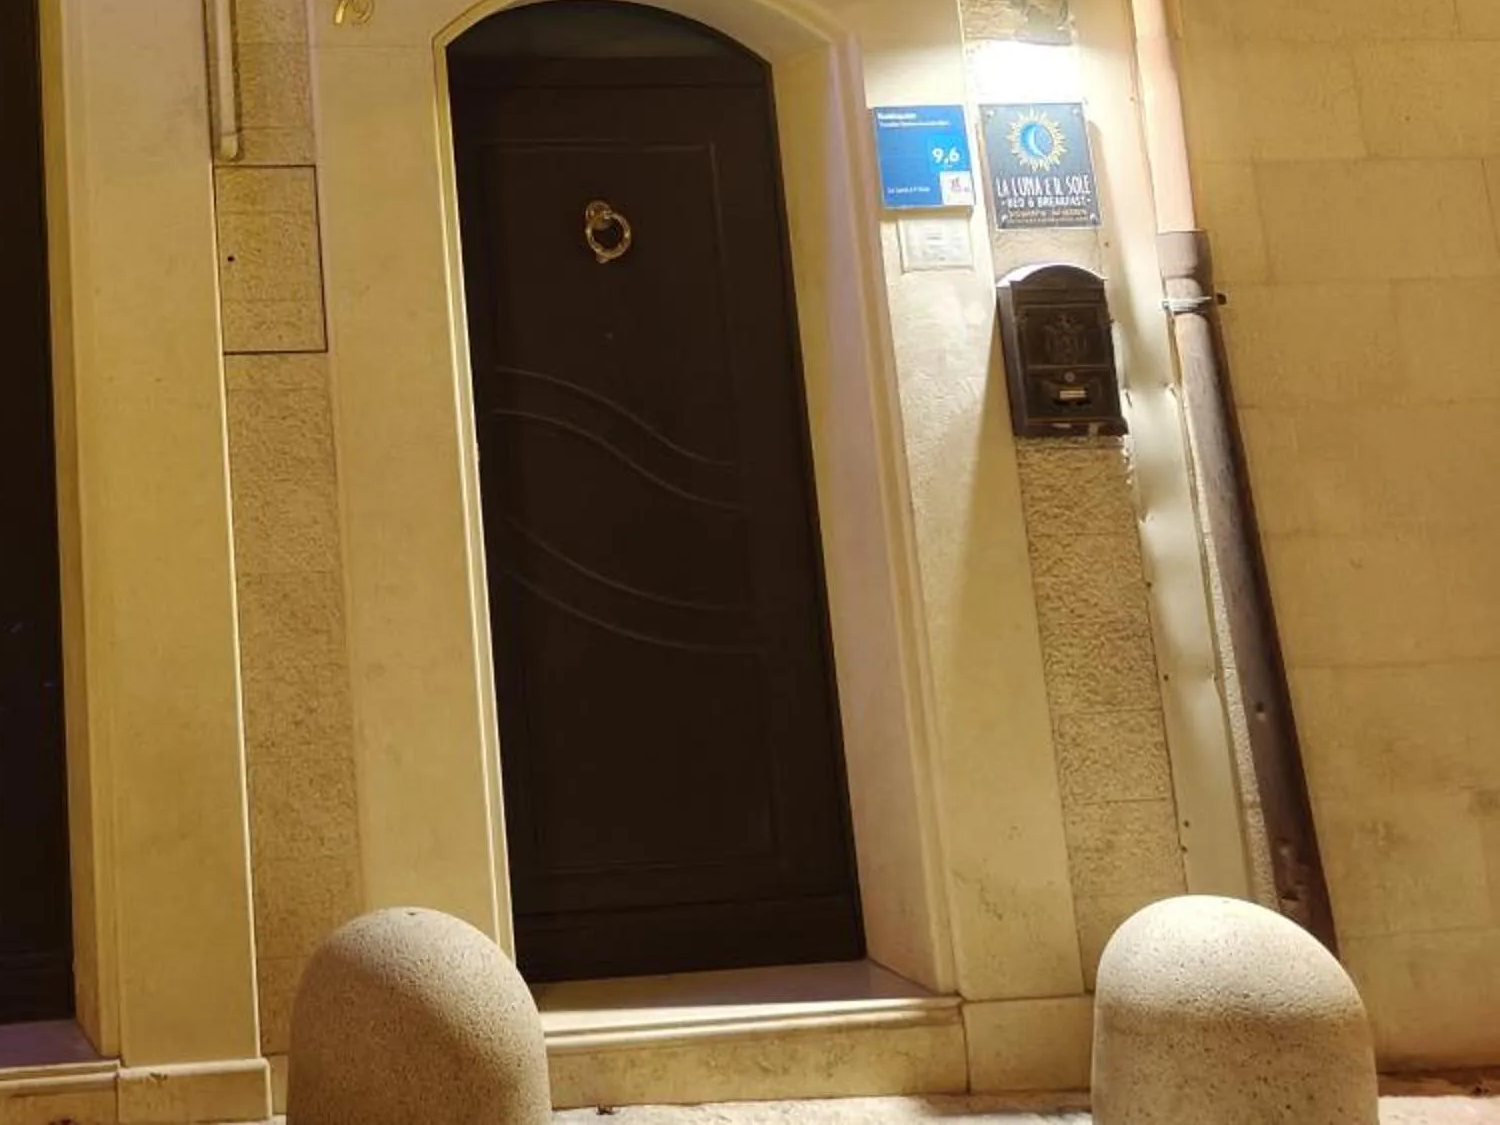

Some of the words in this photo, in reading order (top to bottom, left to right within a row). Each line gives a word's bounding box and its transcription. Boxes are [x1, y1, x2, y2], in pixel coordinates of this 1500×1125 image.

[931, 146, 962, 166] 9,6
[995, 176, 1010, 197] LA
[1011, 176, 1043, 196] LUNA
[1065, 174, 1092, 195] SOLE
